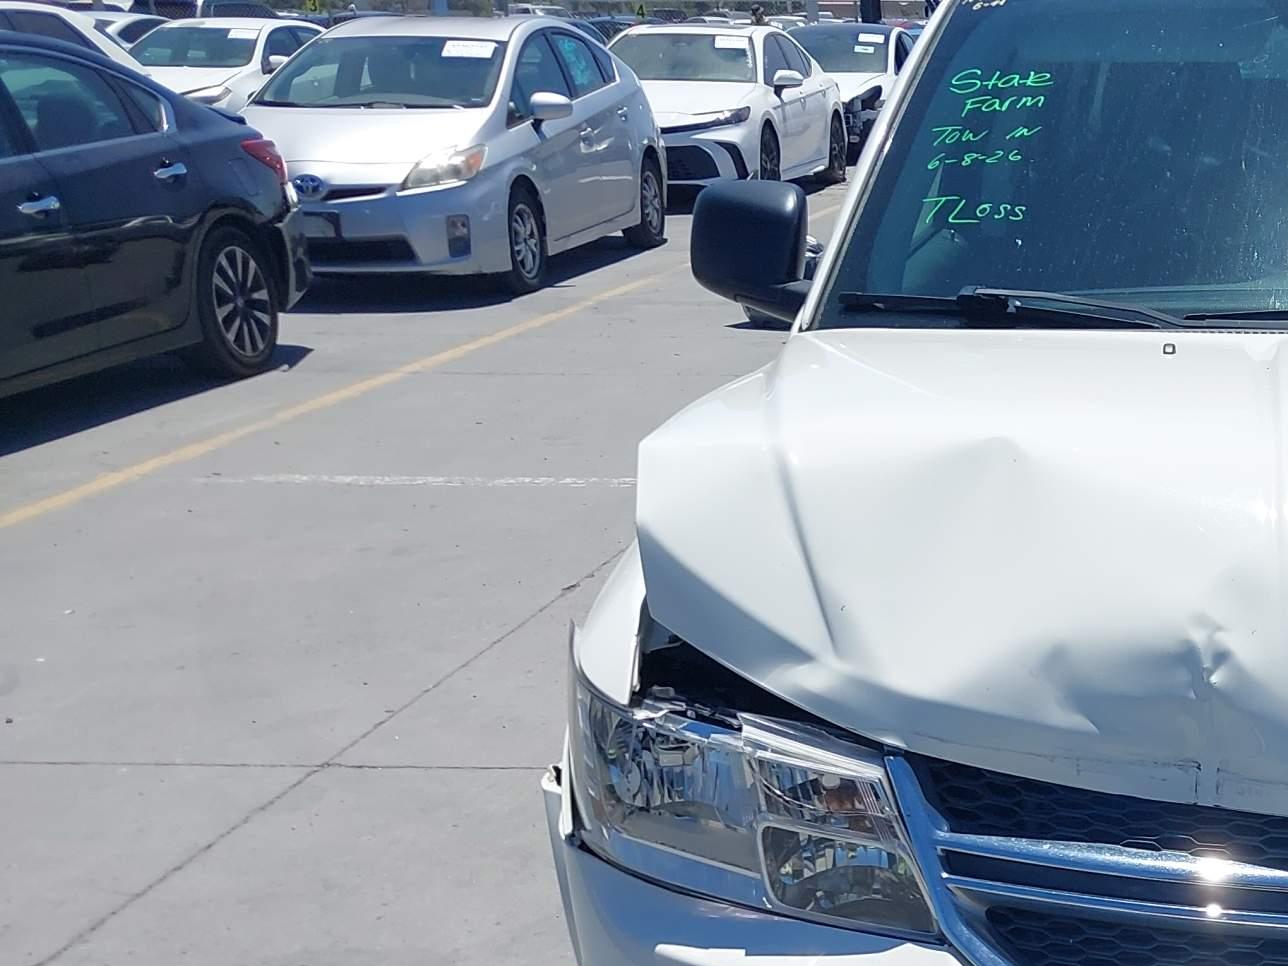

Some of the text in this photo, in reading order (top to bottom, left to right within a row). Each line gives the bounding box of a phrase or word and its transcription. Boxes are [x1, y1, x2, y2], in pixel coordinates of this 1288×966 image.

[636, 4, 646, 18] 4
[950, 69, 1054, 94] State
[961, 95, 1045, 117] Farm
[927, 150, 1022, 170] 6-8-26
